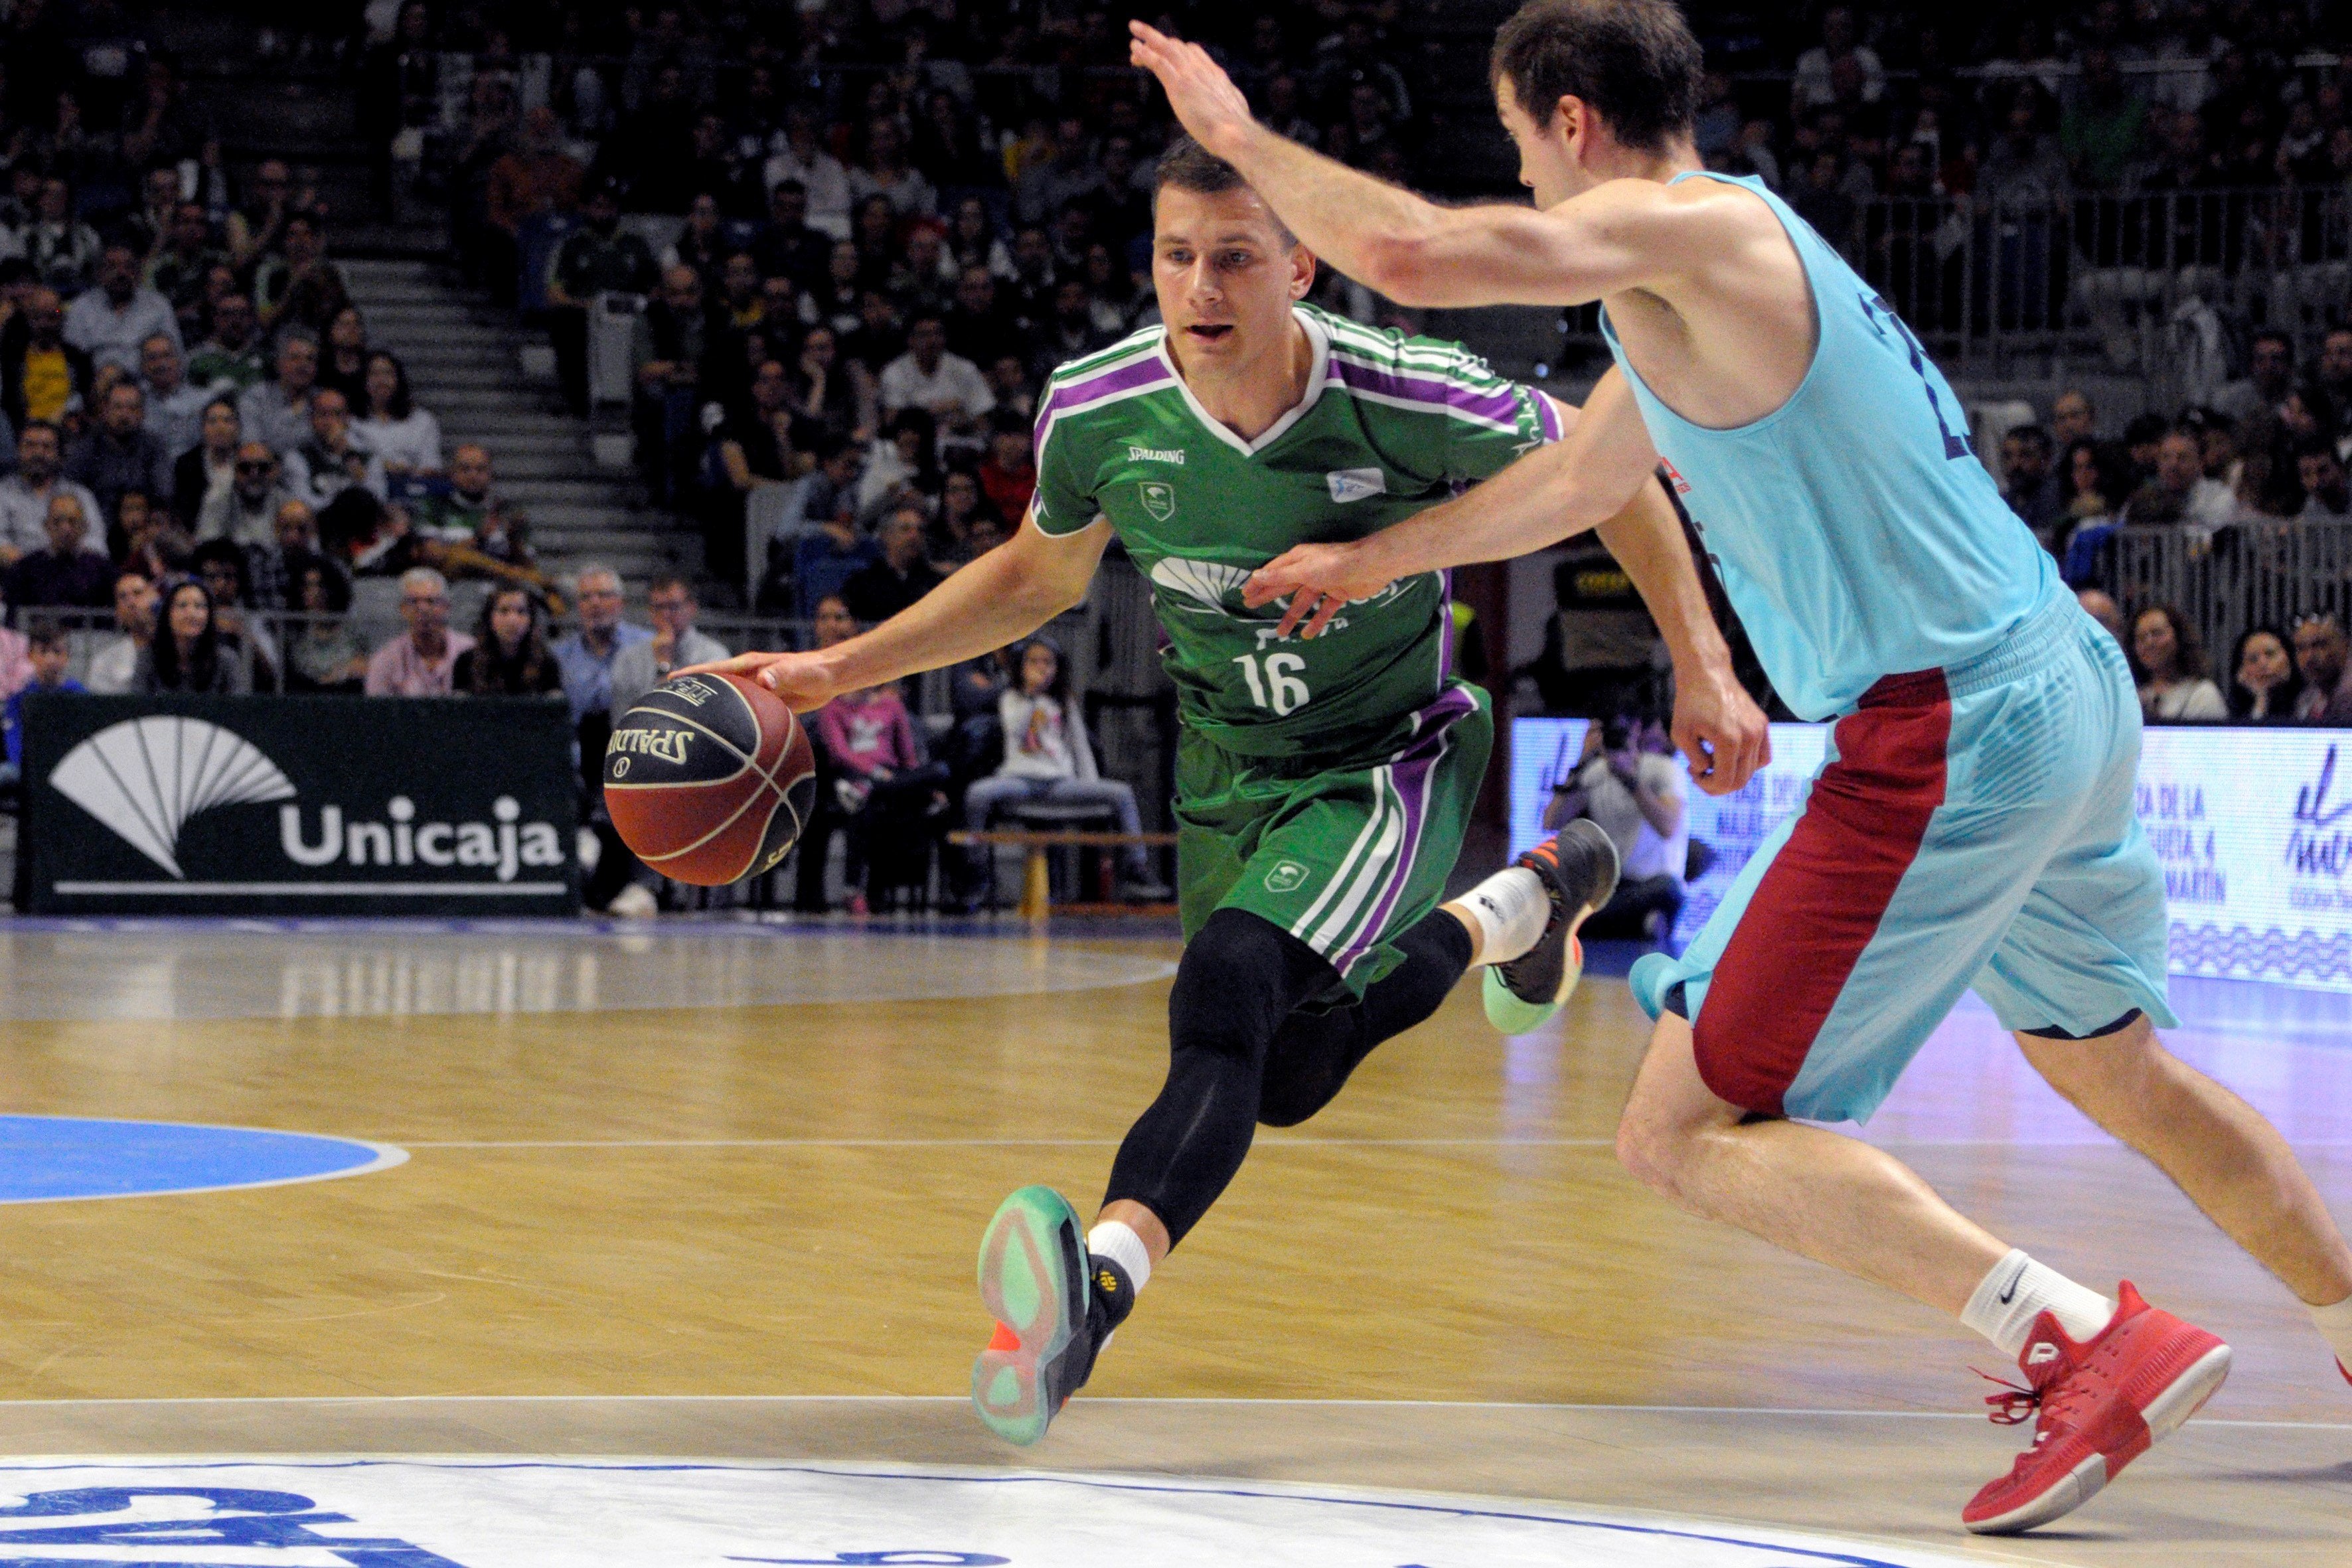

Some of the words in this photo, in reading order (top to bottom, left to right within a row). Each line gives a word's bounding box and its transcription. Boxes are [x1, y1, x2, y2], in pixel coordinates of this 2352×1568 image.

[1129, 447, 1184, 465] SPALDING
[1233, 653, 1310, 716] 16
[280, 797, 566, 882] Unicaja
